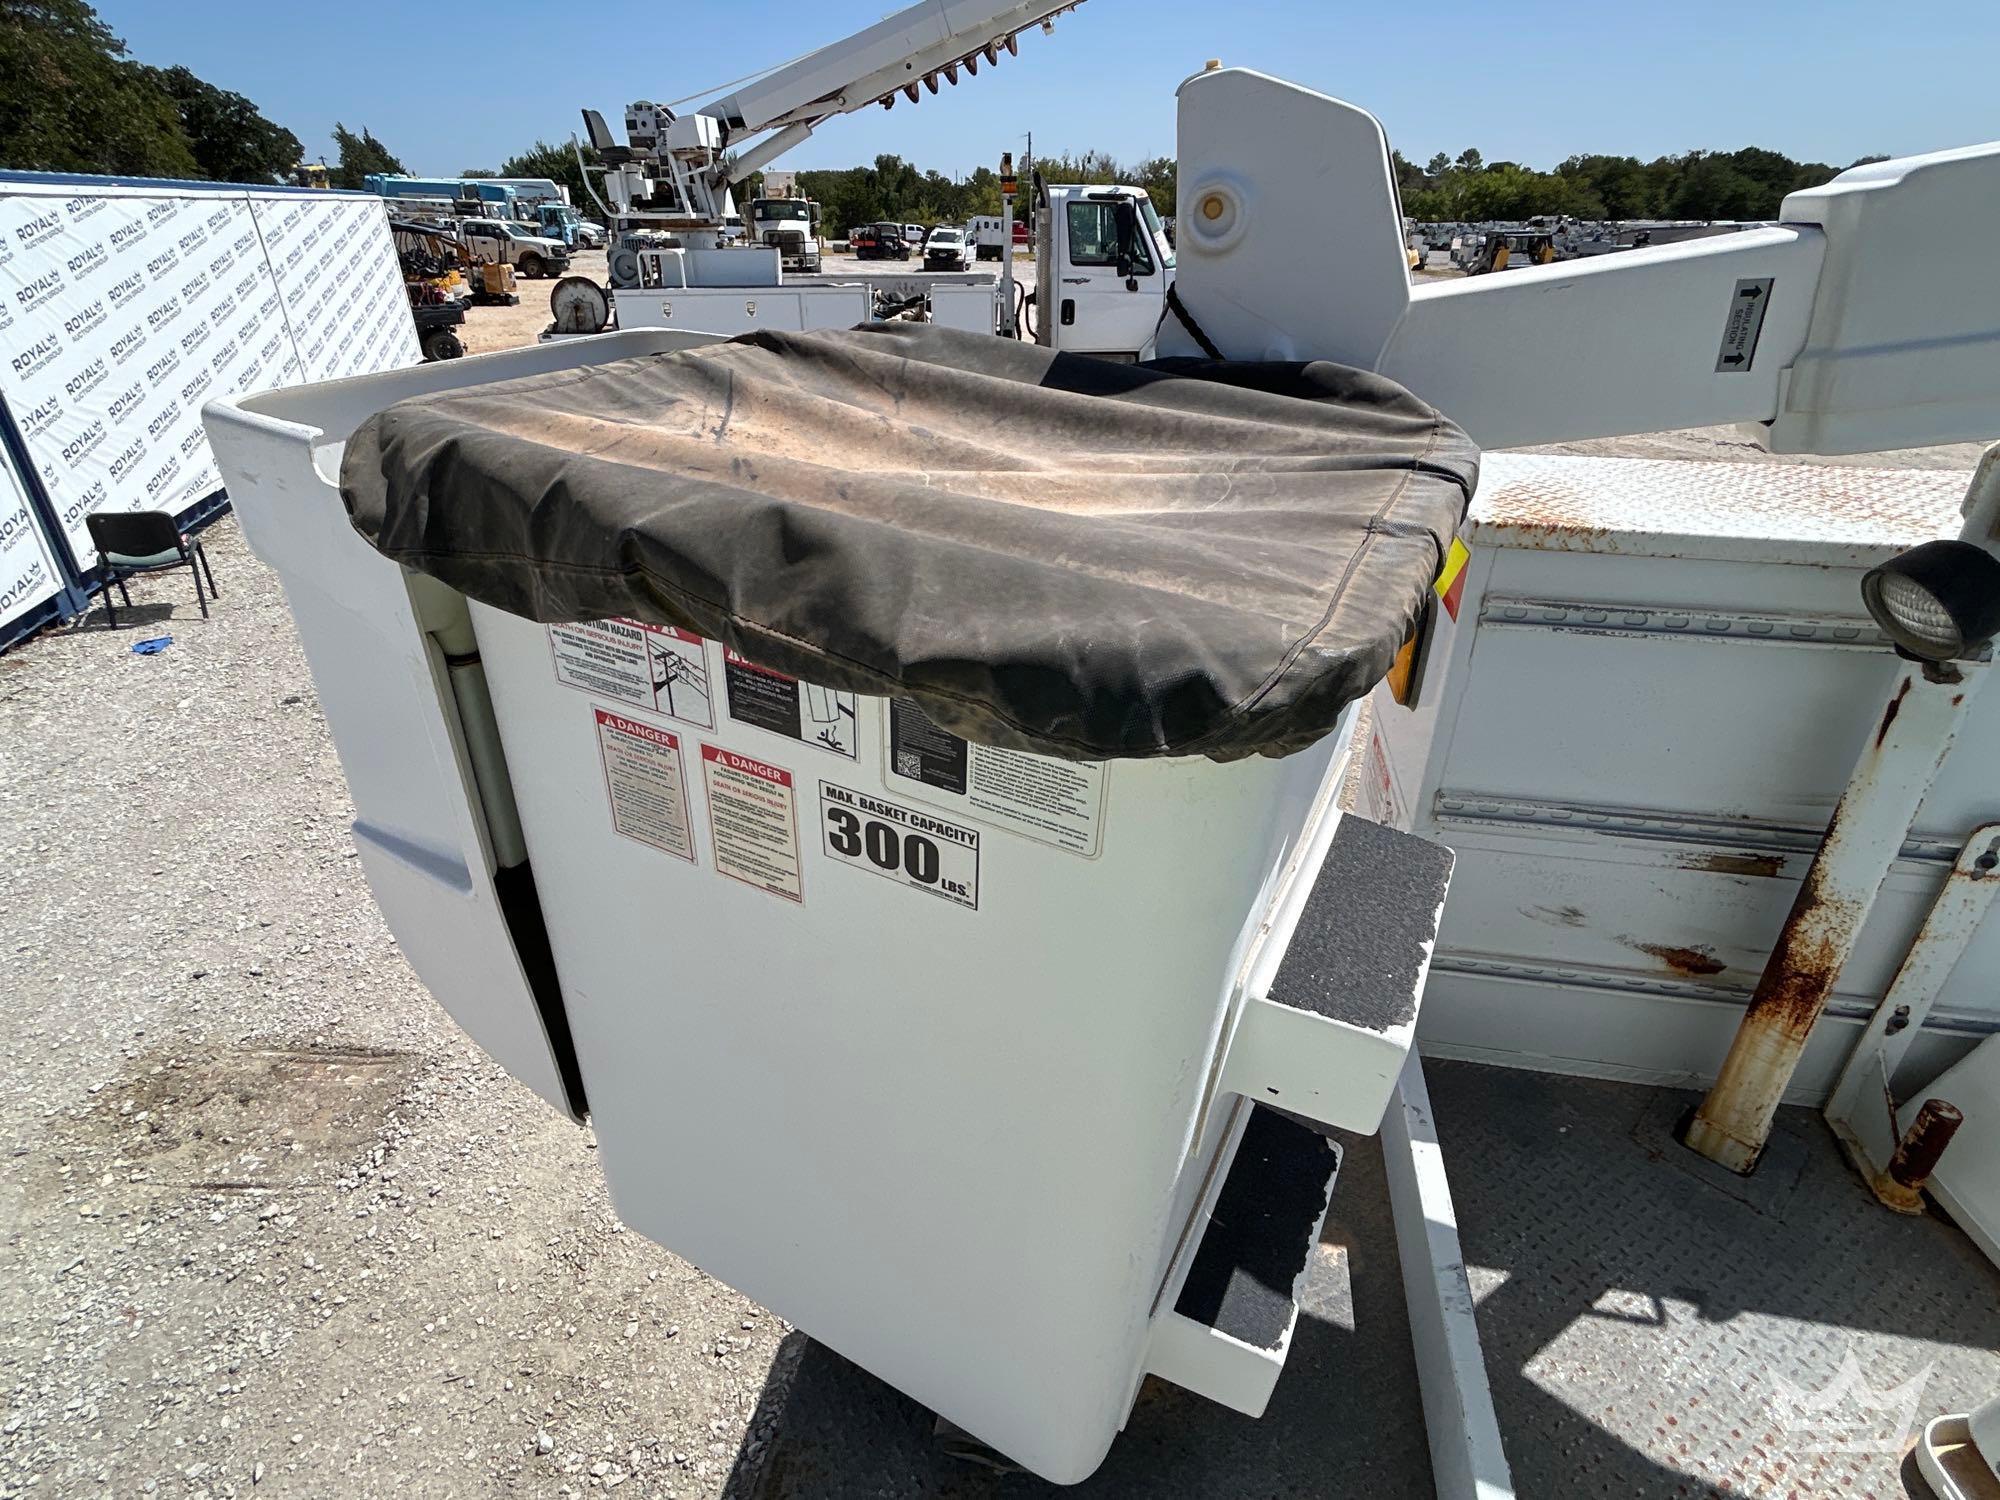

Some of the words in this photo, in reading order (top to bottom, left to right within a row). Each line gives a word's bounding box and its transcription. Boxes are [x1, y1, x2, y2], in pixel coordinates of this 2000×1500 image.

[147, 204, 171, 222] ROYAL
[16, 216, 53, 241] ROYAL
[110, 223, 138, 245] ROYAL
[178, 229, 200, 249] ROYAL
[68, 248, 98, 272] ROYAL
[147, 251, 170, 274] ROYAL
[210, 253, 228, 273] ROYAL
[16, 273, 53, 304] ROYAL
[108, 274, 136, 301] ROYAL
[181, 276, 203, 297] ROYAL
[64, 306, 97, 334] ROYAL
[147, 300, 173, 326] ROYAL
[211, 299, 230, 321] ROYAL
[110, 331, 137, 358] ROYAL
[181, 325, 203, 349] ROYAL
[12, 340, 51, 372] ROYAL
[147, 356, 173, 381] ROYAL
[212, 343, 232, 368] ROYAL
[65, 365, 98, 395] ROYAL
[182, 371, 204, 399] ROYAL
[108, 389, 136, 418] ROYAL
[148, 408, 173, 435] ROYAL
[62, 429, 96, 461] ROYAL
[181, 425, 205, 453] ROYAL
[109, 446, 137, 477] ROYAL
[146, 464, 171, 494] ROYAL
[611, 624, 643, 641] HAZARD
[617, 719, 670, 745] DANGER
[713, 770, 745, 785] FOLLOWING
[731, 755, 782, 782] DANGER
[742, 788, 766, 803] SERIOUS
[825, 786, 857, 806] MAX.
[859, 797, 908, 823] BASKET
[910, 814, 976, 846] CAPACITY
[827, 807, 940, 884] 300
[941, 878, 970, 898] LBS.
